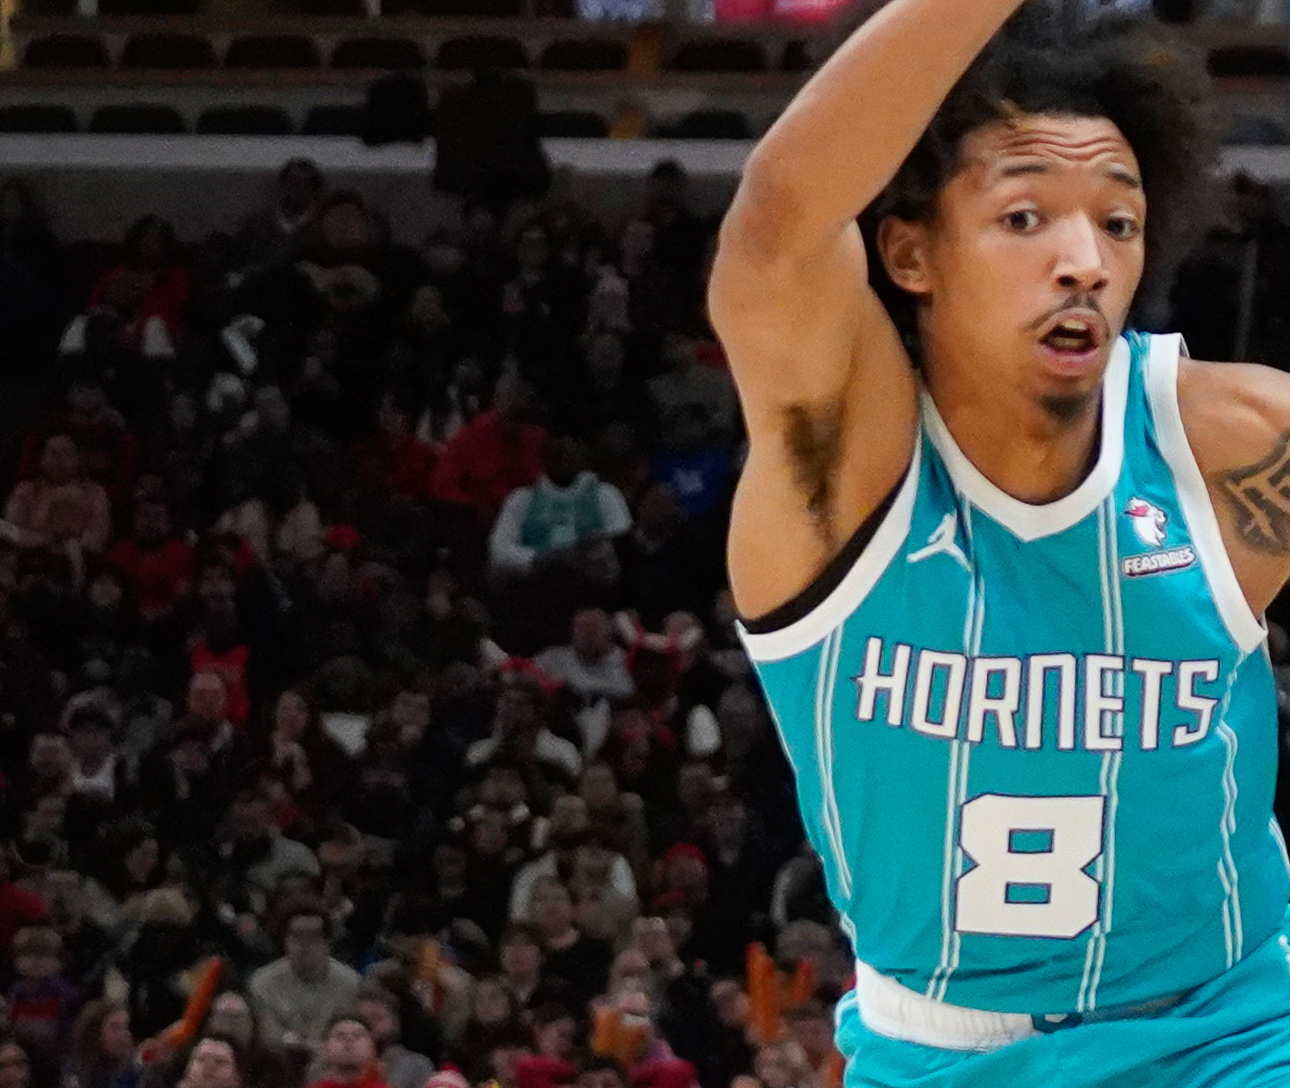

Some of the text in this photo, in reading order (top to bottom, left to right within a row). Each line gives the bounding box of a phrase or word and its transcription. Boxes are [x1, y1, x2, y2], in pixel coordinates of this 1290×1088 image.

[1123, 547, 1196, 576] FEASTABLES
[854, 636, 1221, 752] HORNETS
[955, 792, 1107, 940] 8
